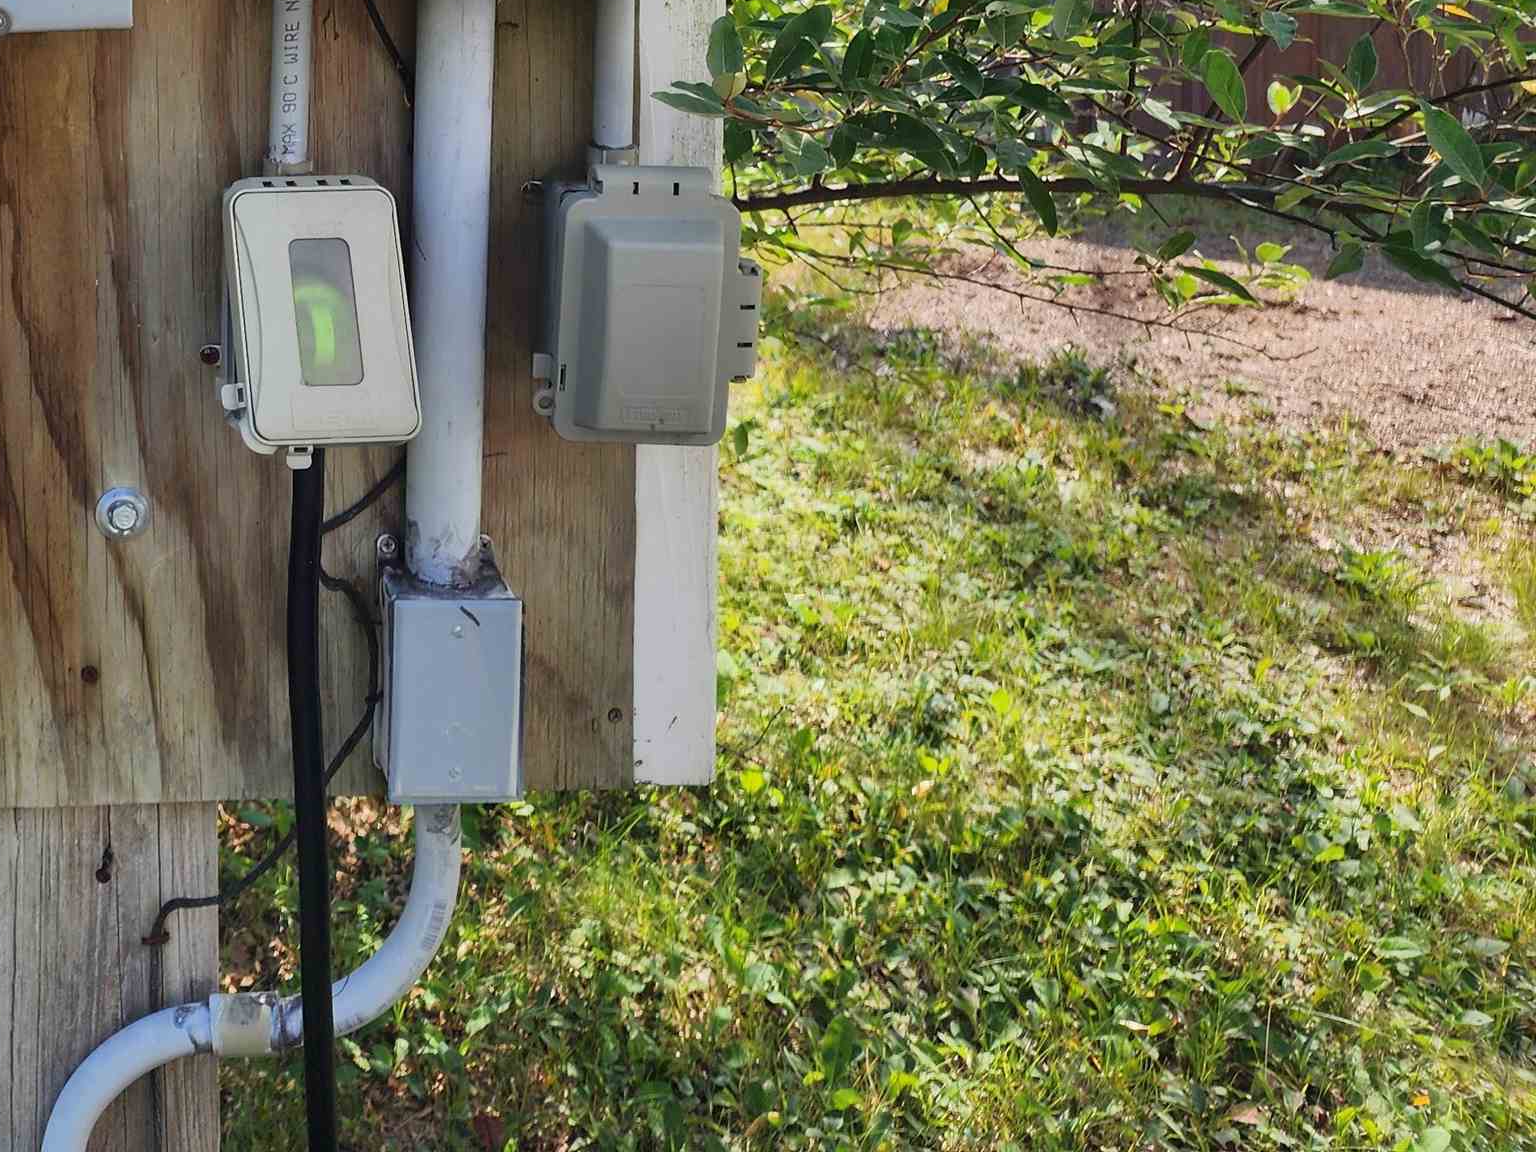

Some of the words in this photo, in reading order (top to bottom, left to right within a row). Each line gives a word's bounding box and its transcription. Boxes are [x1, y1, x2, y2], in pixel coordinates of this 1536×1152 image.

[283, 21, 300, 65] WIRE
[283, 74, 298, 86] C
[282, 92, 297, 113] 90
[281, 123, 297, 155] MAX
